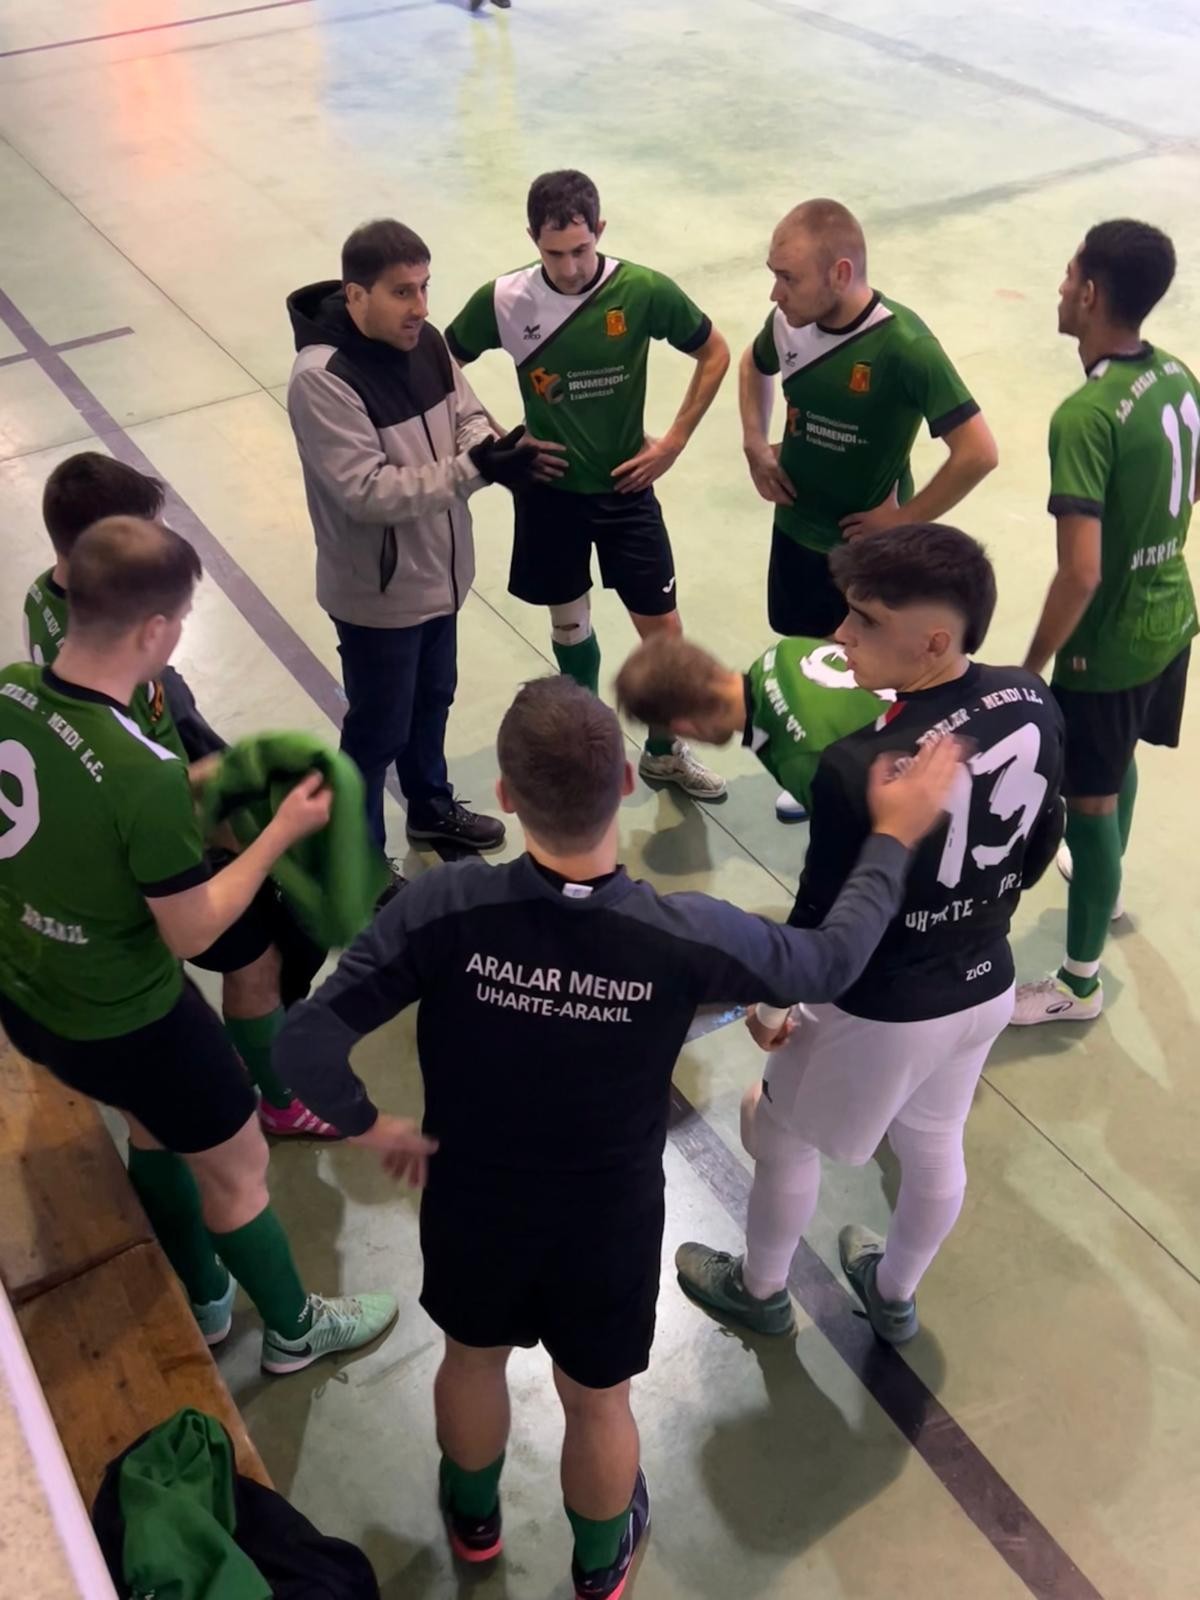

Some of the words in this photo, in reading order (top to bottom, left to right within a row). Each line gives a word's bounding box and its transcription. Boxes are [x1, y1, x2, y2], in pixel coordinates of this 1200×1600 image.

[568, 374, 624, 392] IRUMENDI
[981, 687, 1022, 710] MENDI
[47, 711, 84, 752] MENDI
[80, 747, 105, 784] K.E.
[937, 722, 1048, 890] 13
[465, 952, 562, 992] ARALAR
[568, 970, 654, 1002] MENDI
[965, 960, 993, 982] ZICO
[475, 982, 633, 1023] UHARTE-ARAKIL
